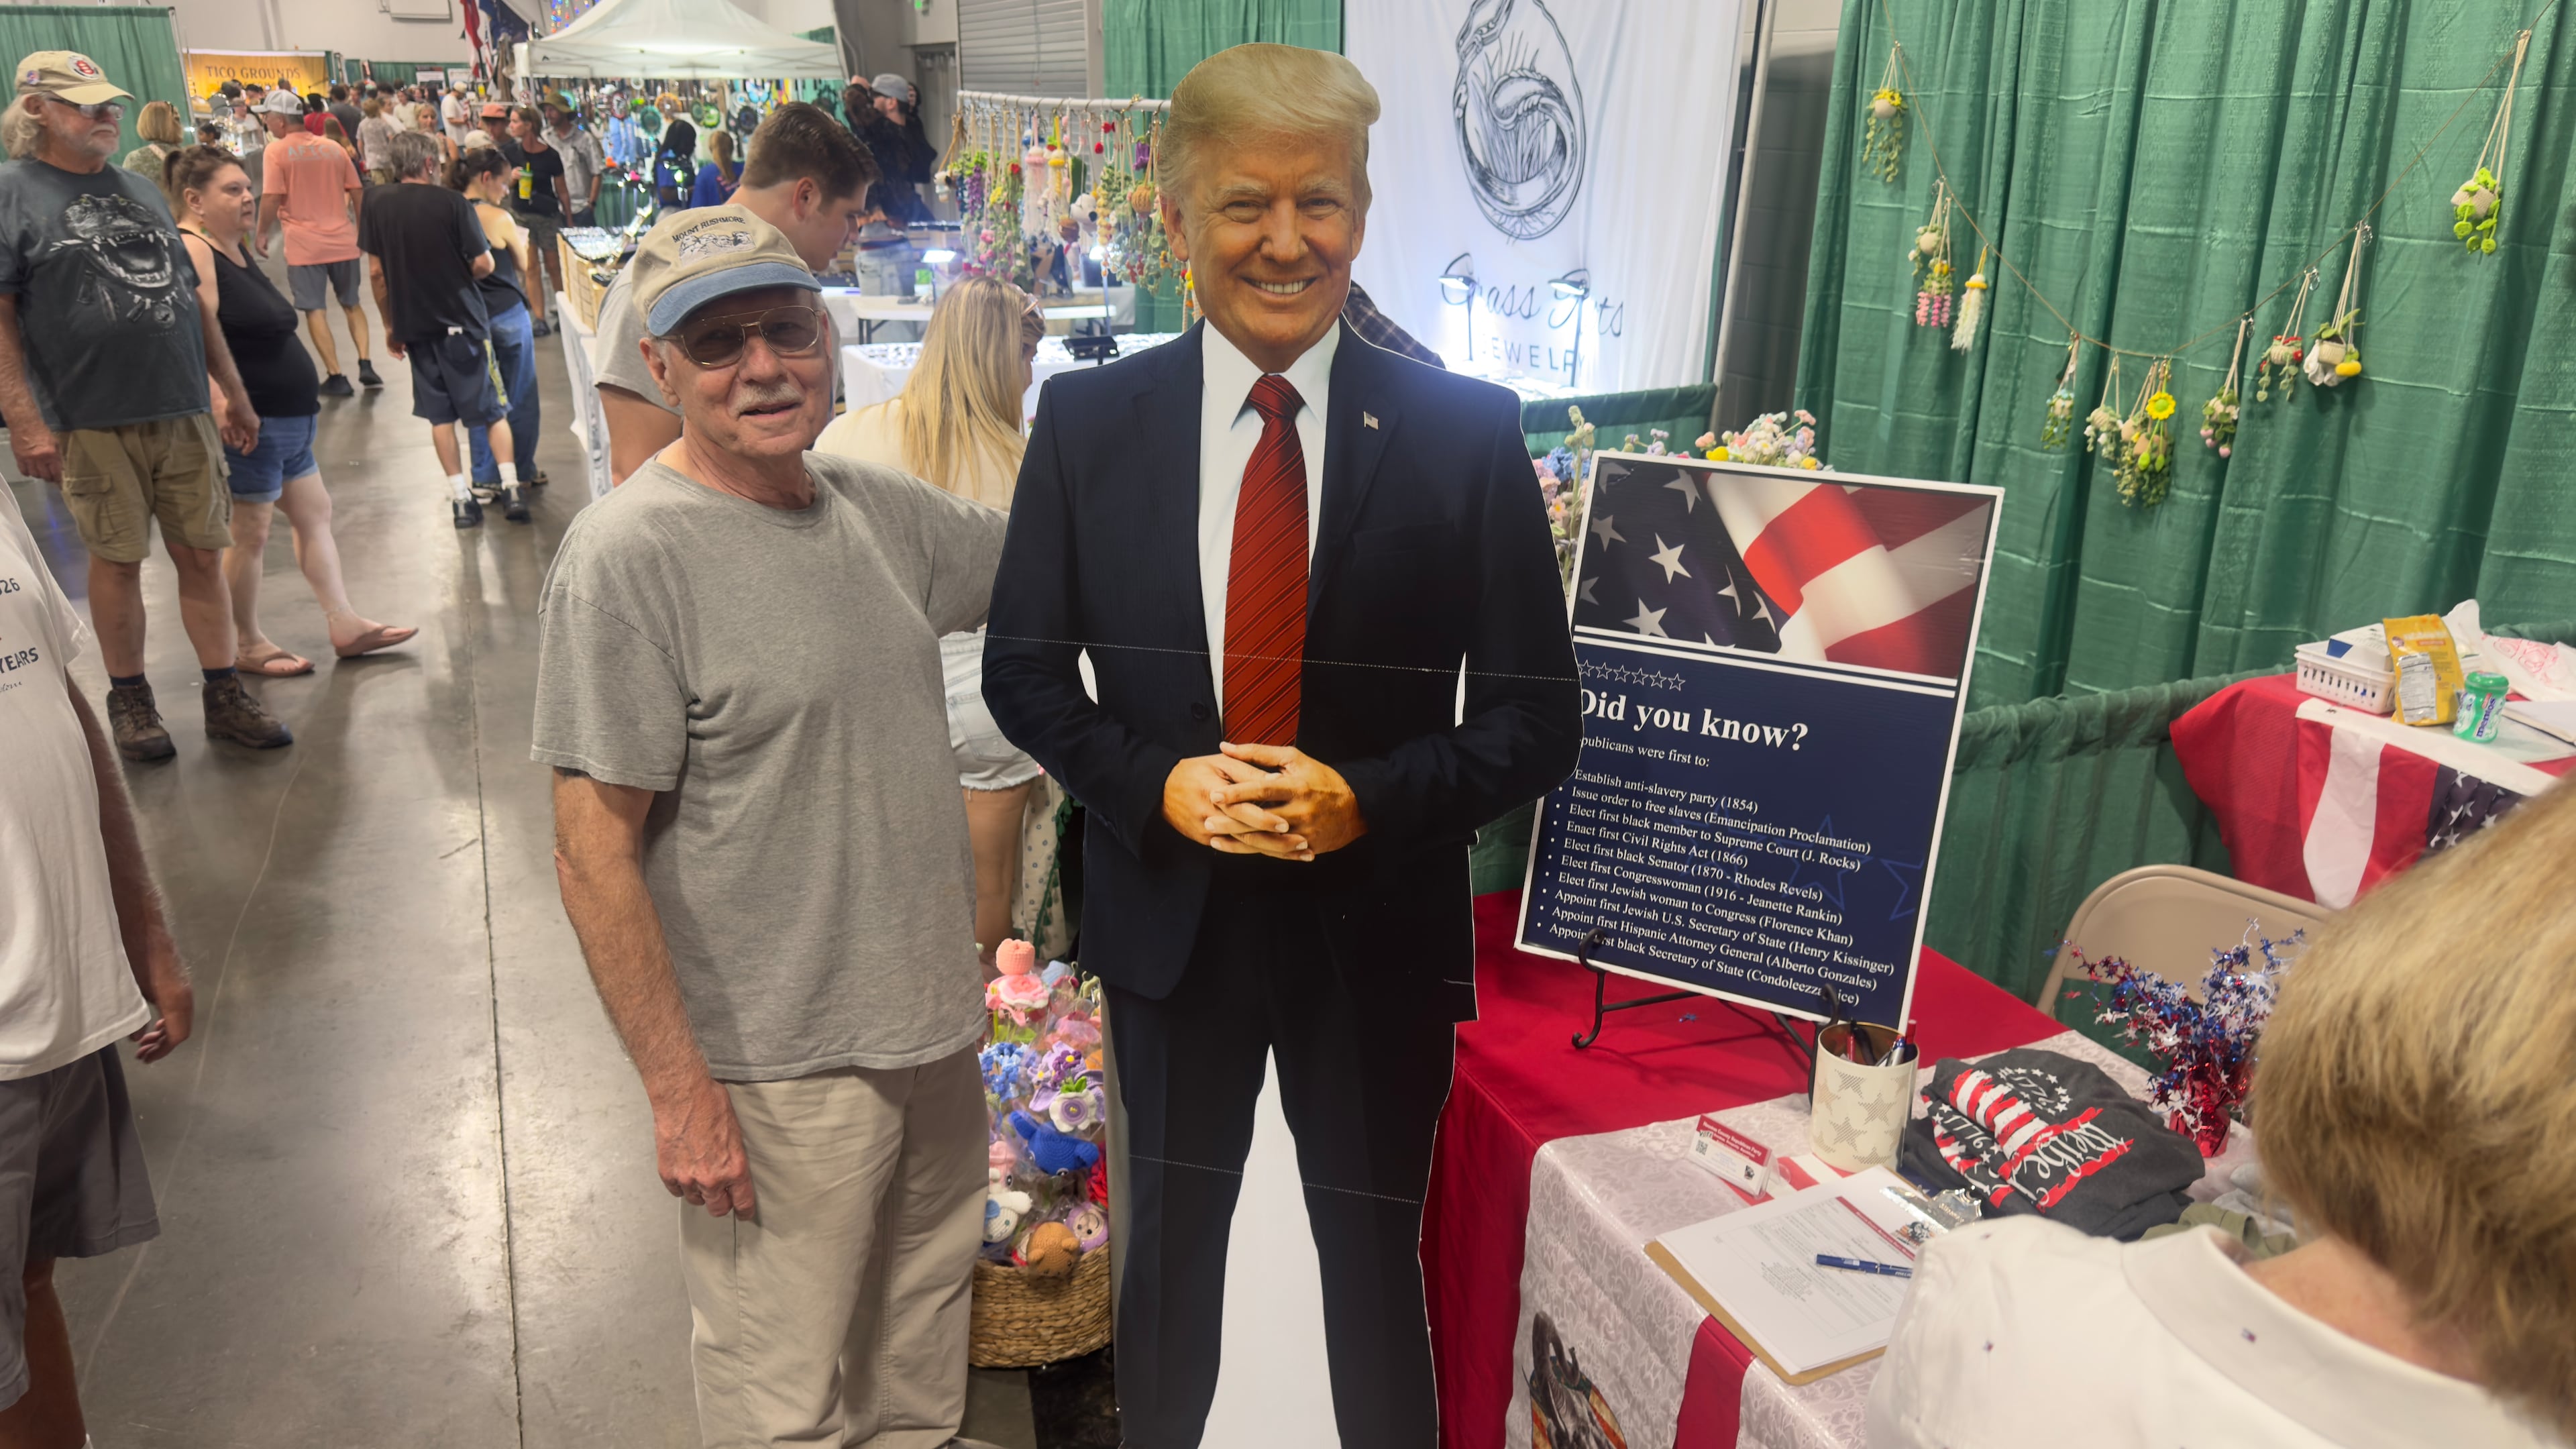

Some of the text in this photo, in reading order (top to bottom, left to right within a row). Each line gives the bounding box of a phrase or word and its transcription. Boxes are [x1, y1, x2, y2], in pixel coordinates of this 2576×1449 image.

[205, 65, 301, 80] TICO GROUNDS
[672, 215, 746, 243] MOUNT RUSHMORE
[1580, 688, 1809, 751] Did you know?
[2476, 697, 2496, 737] mentos
[1579, 735, 1710, 767] publicans were first to:
[1571, 786, 1871, 855] Issue order to free slaves (Emancipation Proclamation)
[1574, 768, 1758, 814] Establish anti-slavery party (1854)
[1566, 820, 1749, 869] Enact first Civil Rights Act (1866)
[1568, 802, 1861, 872] Elect first black member to Supreme Court (J. Rocks)
[1560, 854, 1587, 870] Elect
[1589, 860, 1611, 875] first
[1613, 865, 1701, 894] Congresswoman
[1703, 885, 1737, 901] (1916
[1746, 893, 1793, 914] Jeanette
[1795, 903, 1842, 926] Rankin)
[1563, 837, 1590, 853] Elect
[1593, 843, 1613, 857] first
[1615, 847, 1644, 864] black
[1648, 854, 1689, 873] Senator
[1690, 863, 1723, 880] (1870
[1733, 871, 1776, 891] Rhodes
[1778, 881, 1823, 902] Revels)
[1554, 888, 1894, 976] Appoint first Jewish U.S. Secretary of State (Henry Kissinger)
[1558, 871, 1854, 947] Elect first Jewish woman to Congress (Florence Khan)
[1551, 906, 1877, 991] Appoint first Hispanic Attorney General (Alberto Gonzales)
[1617, 937, 1646, 955] black
[1648, 945, 1700, 969] Secretary
[1701, 959, 1716, 970] of
[1716, 961, 1744, 977] State
[1837, 988, 1860, 1007] ice)
[1943, 1114, 1994, 1149] 1776
